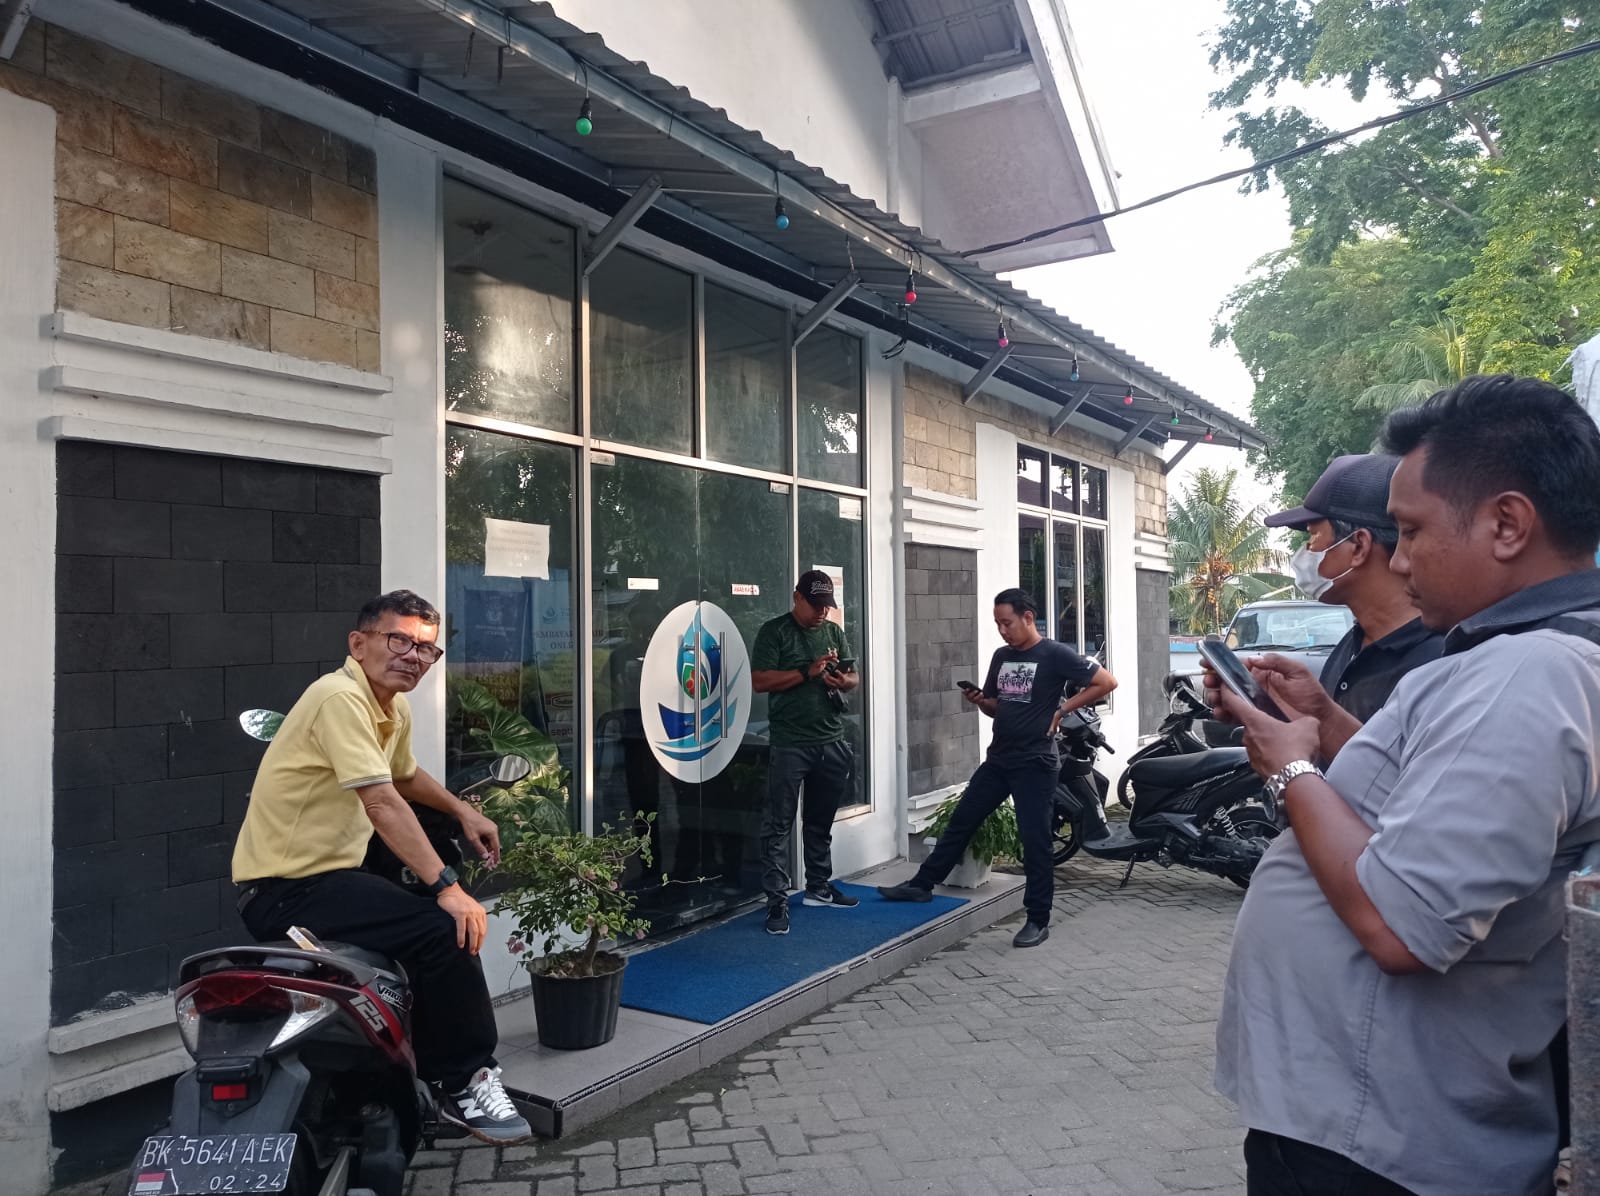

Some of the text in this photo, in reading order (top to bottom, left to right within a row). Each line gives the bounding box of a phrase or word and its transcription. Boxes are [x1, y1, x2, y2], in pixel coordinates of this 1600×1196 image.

[348, 993, 389, 1033] 125
[142, 1136, 291, 1168] BK 5641 AEK
